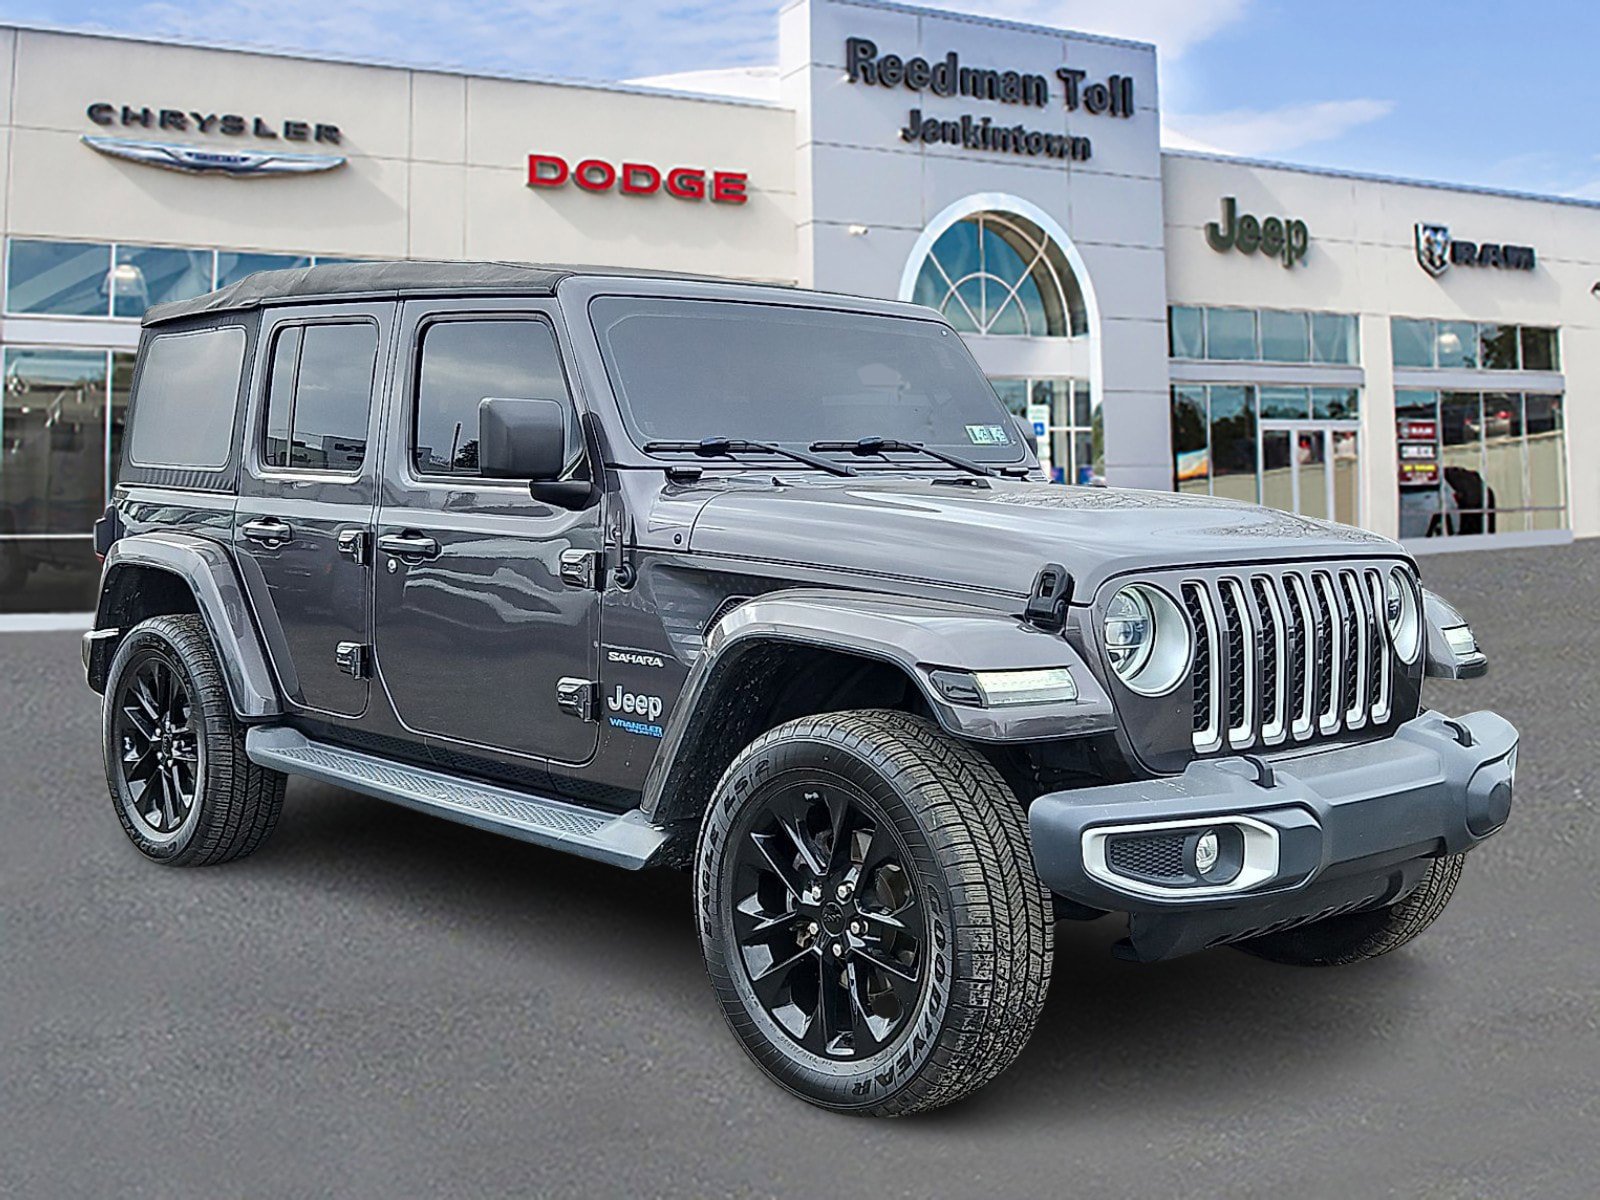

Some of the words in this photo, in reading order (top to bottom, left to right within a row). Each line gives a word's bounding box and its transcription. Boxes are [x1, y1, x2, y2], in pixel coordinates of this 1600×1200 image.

[845, 36, 1049, 107] Reedman
[1056, 67, 1135, 119] Toll
[87, 102, 341, 145] CHRYSLER
[901, 108, 1092, 161] Jenkintown
[527, 153, 748, 206] DODGE
[1204, 196, 1308, 270] Jeep
[1451, 240, 1536, 271] RAM
[607, 650, 664, 668] SAHARA
[607, 685, 663, 722] Jeep
[608, 716, 663, 734] WRANGLER
[851, 883, 945, 1096] GOODYEAR
